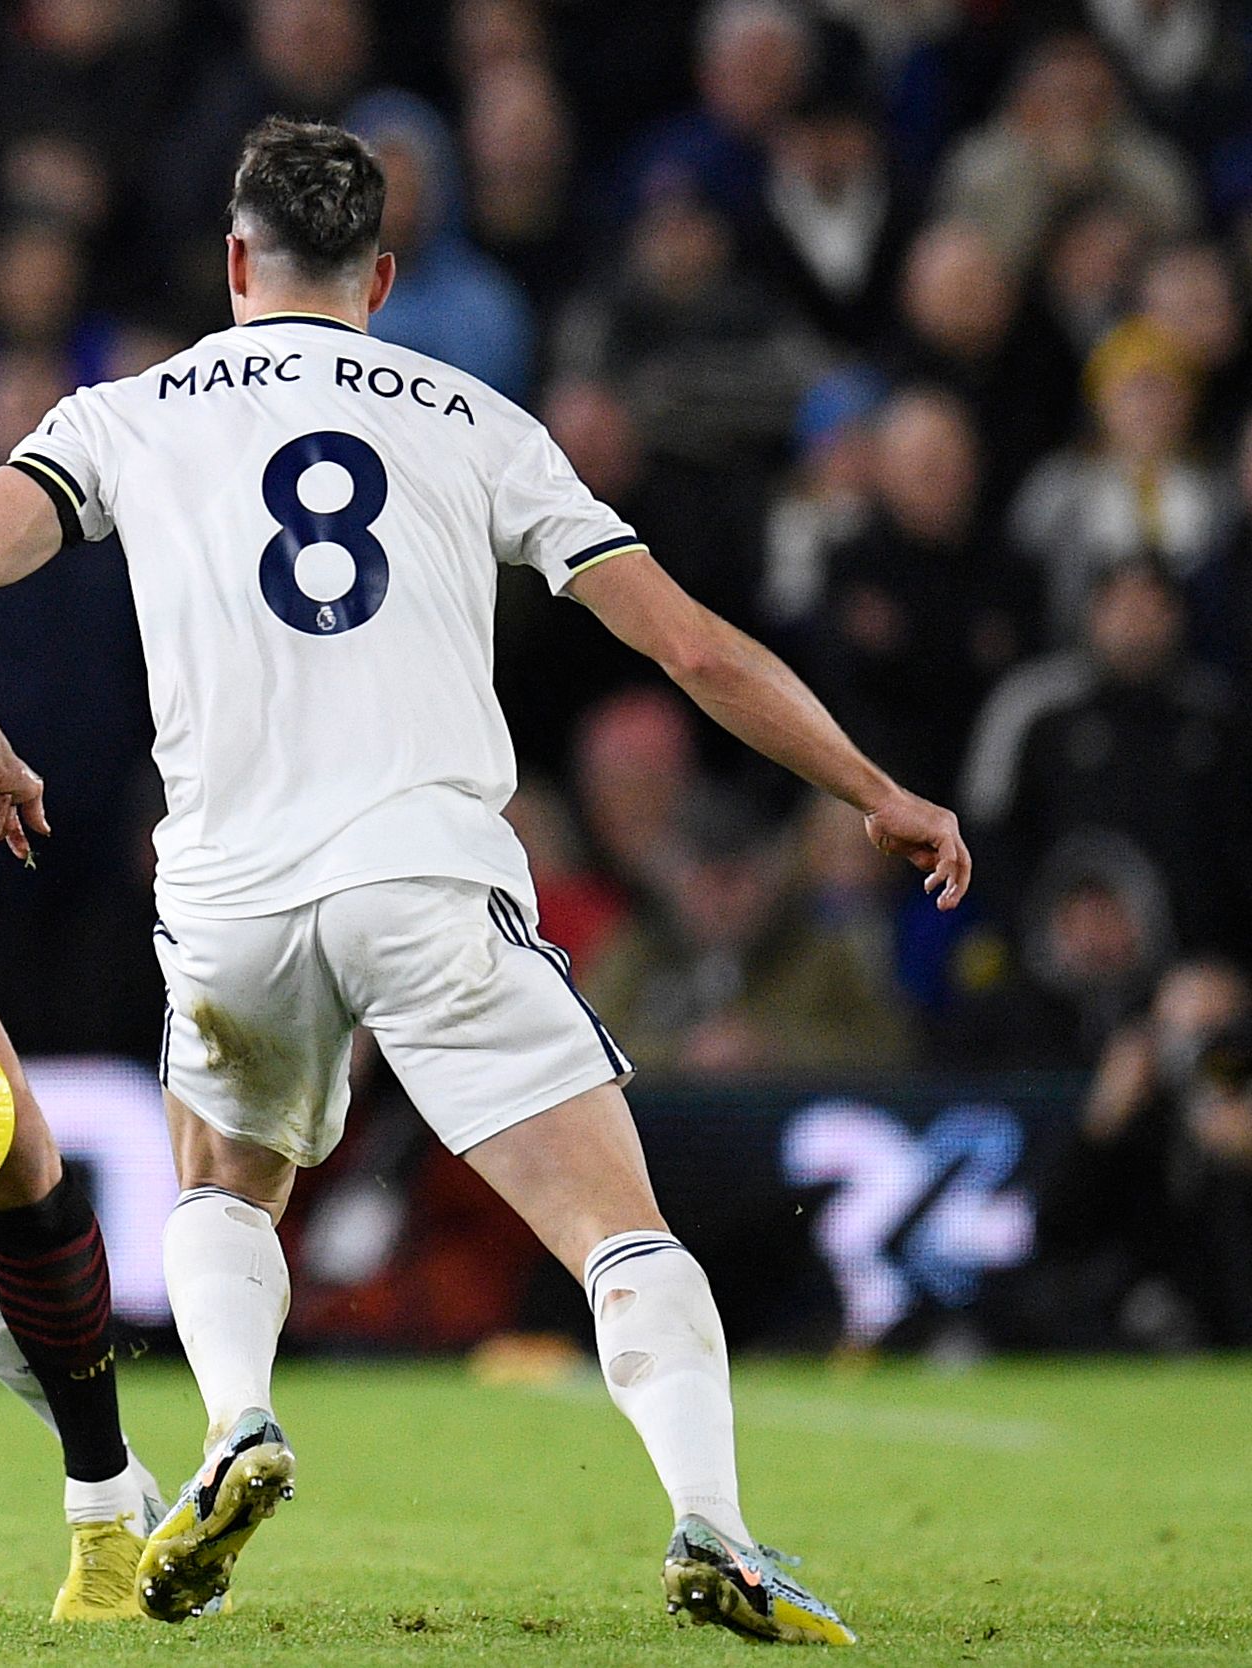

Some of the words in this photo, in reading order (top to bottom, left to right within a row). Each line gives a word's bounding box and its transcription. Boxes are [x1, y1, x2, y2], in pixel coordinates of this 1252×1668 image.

[158, 354, 302, 399] MARC
[335, 357, 475, 425] ROCA
[259, 431, 389, 635] 8
